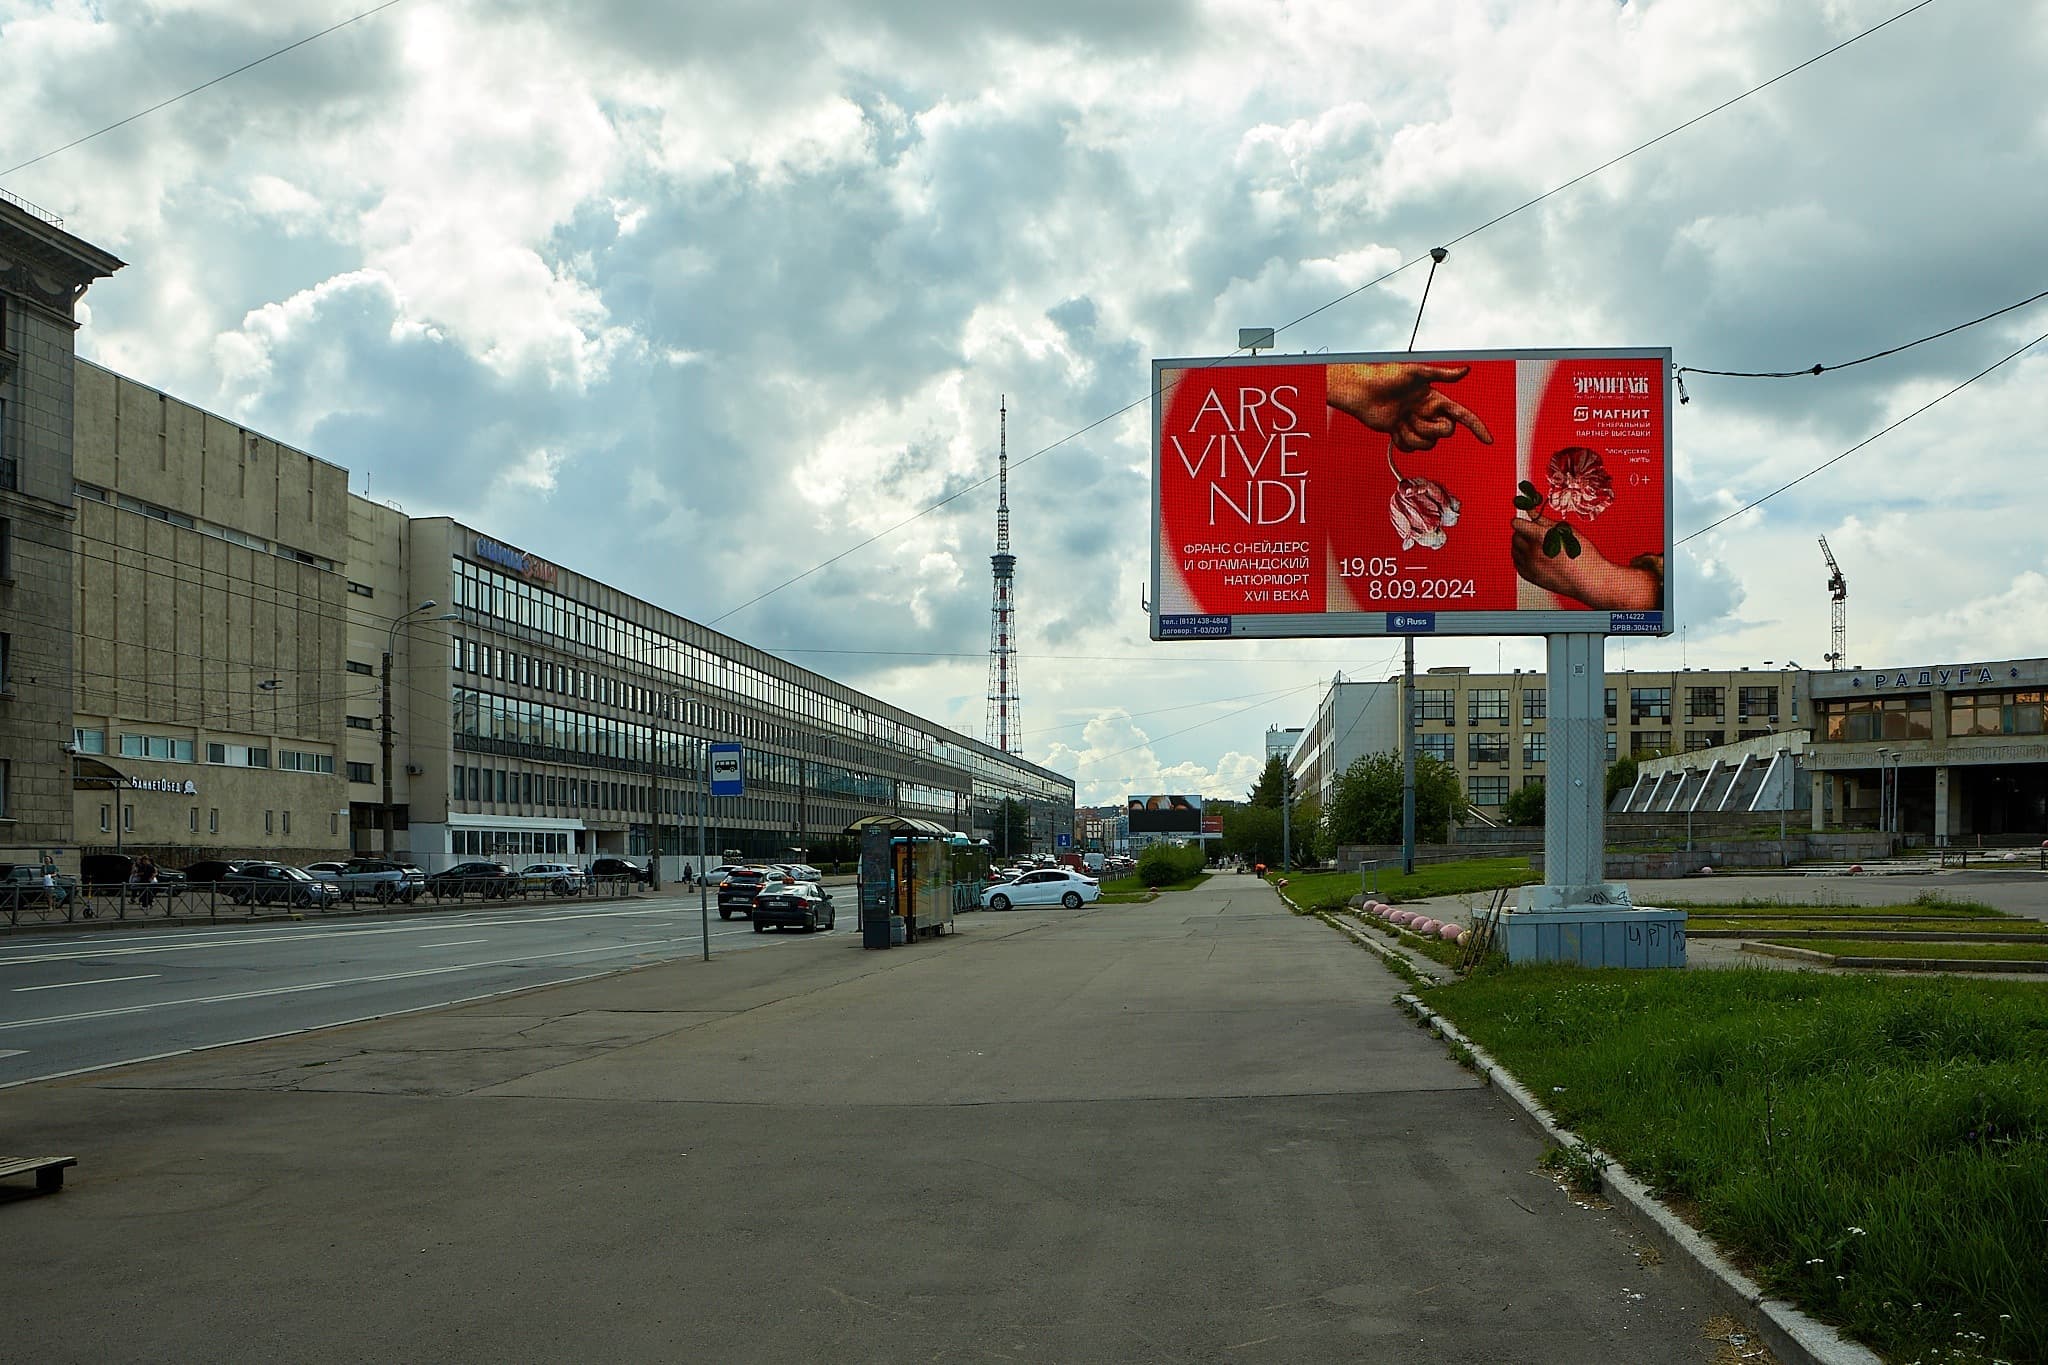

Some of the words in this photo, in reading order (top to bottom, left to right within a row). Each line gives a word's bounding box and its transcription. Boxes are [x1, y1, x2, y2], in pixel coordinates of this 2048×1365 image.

[1573, 376, 1649, 394] ЭРМИТАЖ
[1187, 384, 1298, 441] ARS
[1592, 408, 1650, 419] МАГНИТ
[1170, 432, 1311, 479] VIVE
[1183, 542, 1232, 554] ФРАНС
[1233, 540, 1310, 554] СНЕЙДЕРС
[1184, 559, 1194, 571] И
[1197, 556, 1309, 571] ФЛАМАНДСКИЙ
[1339, 557, 1398, 577] 19.05
[1224, 573, 1310, 586] НАТЮРМОРТ
[1244, 590, 1269, 602] XVII
[1273, 589, 1310, 601] ВЕКА
[1369, 579, 1476, 600] 8.09.2024
[1179, 616, 1196, 625] (812)
[1406, 617, 1427, 626] Russ
[1162, 627, 1192, 636] договор:
[1875, 666, 1994, 689] РАДУГА
